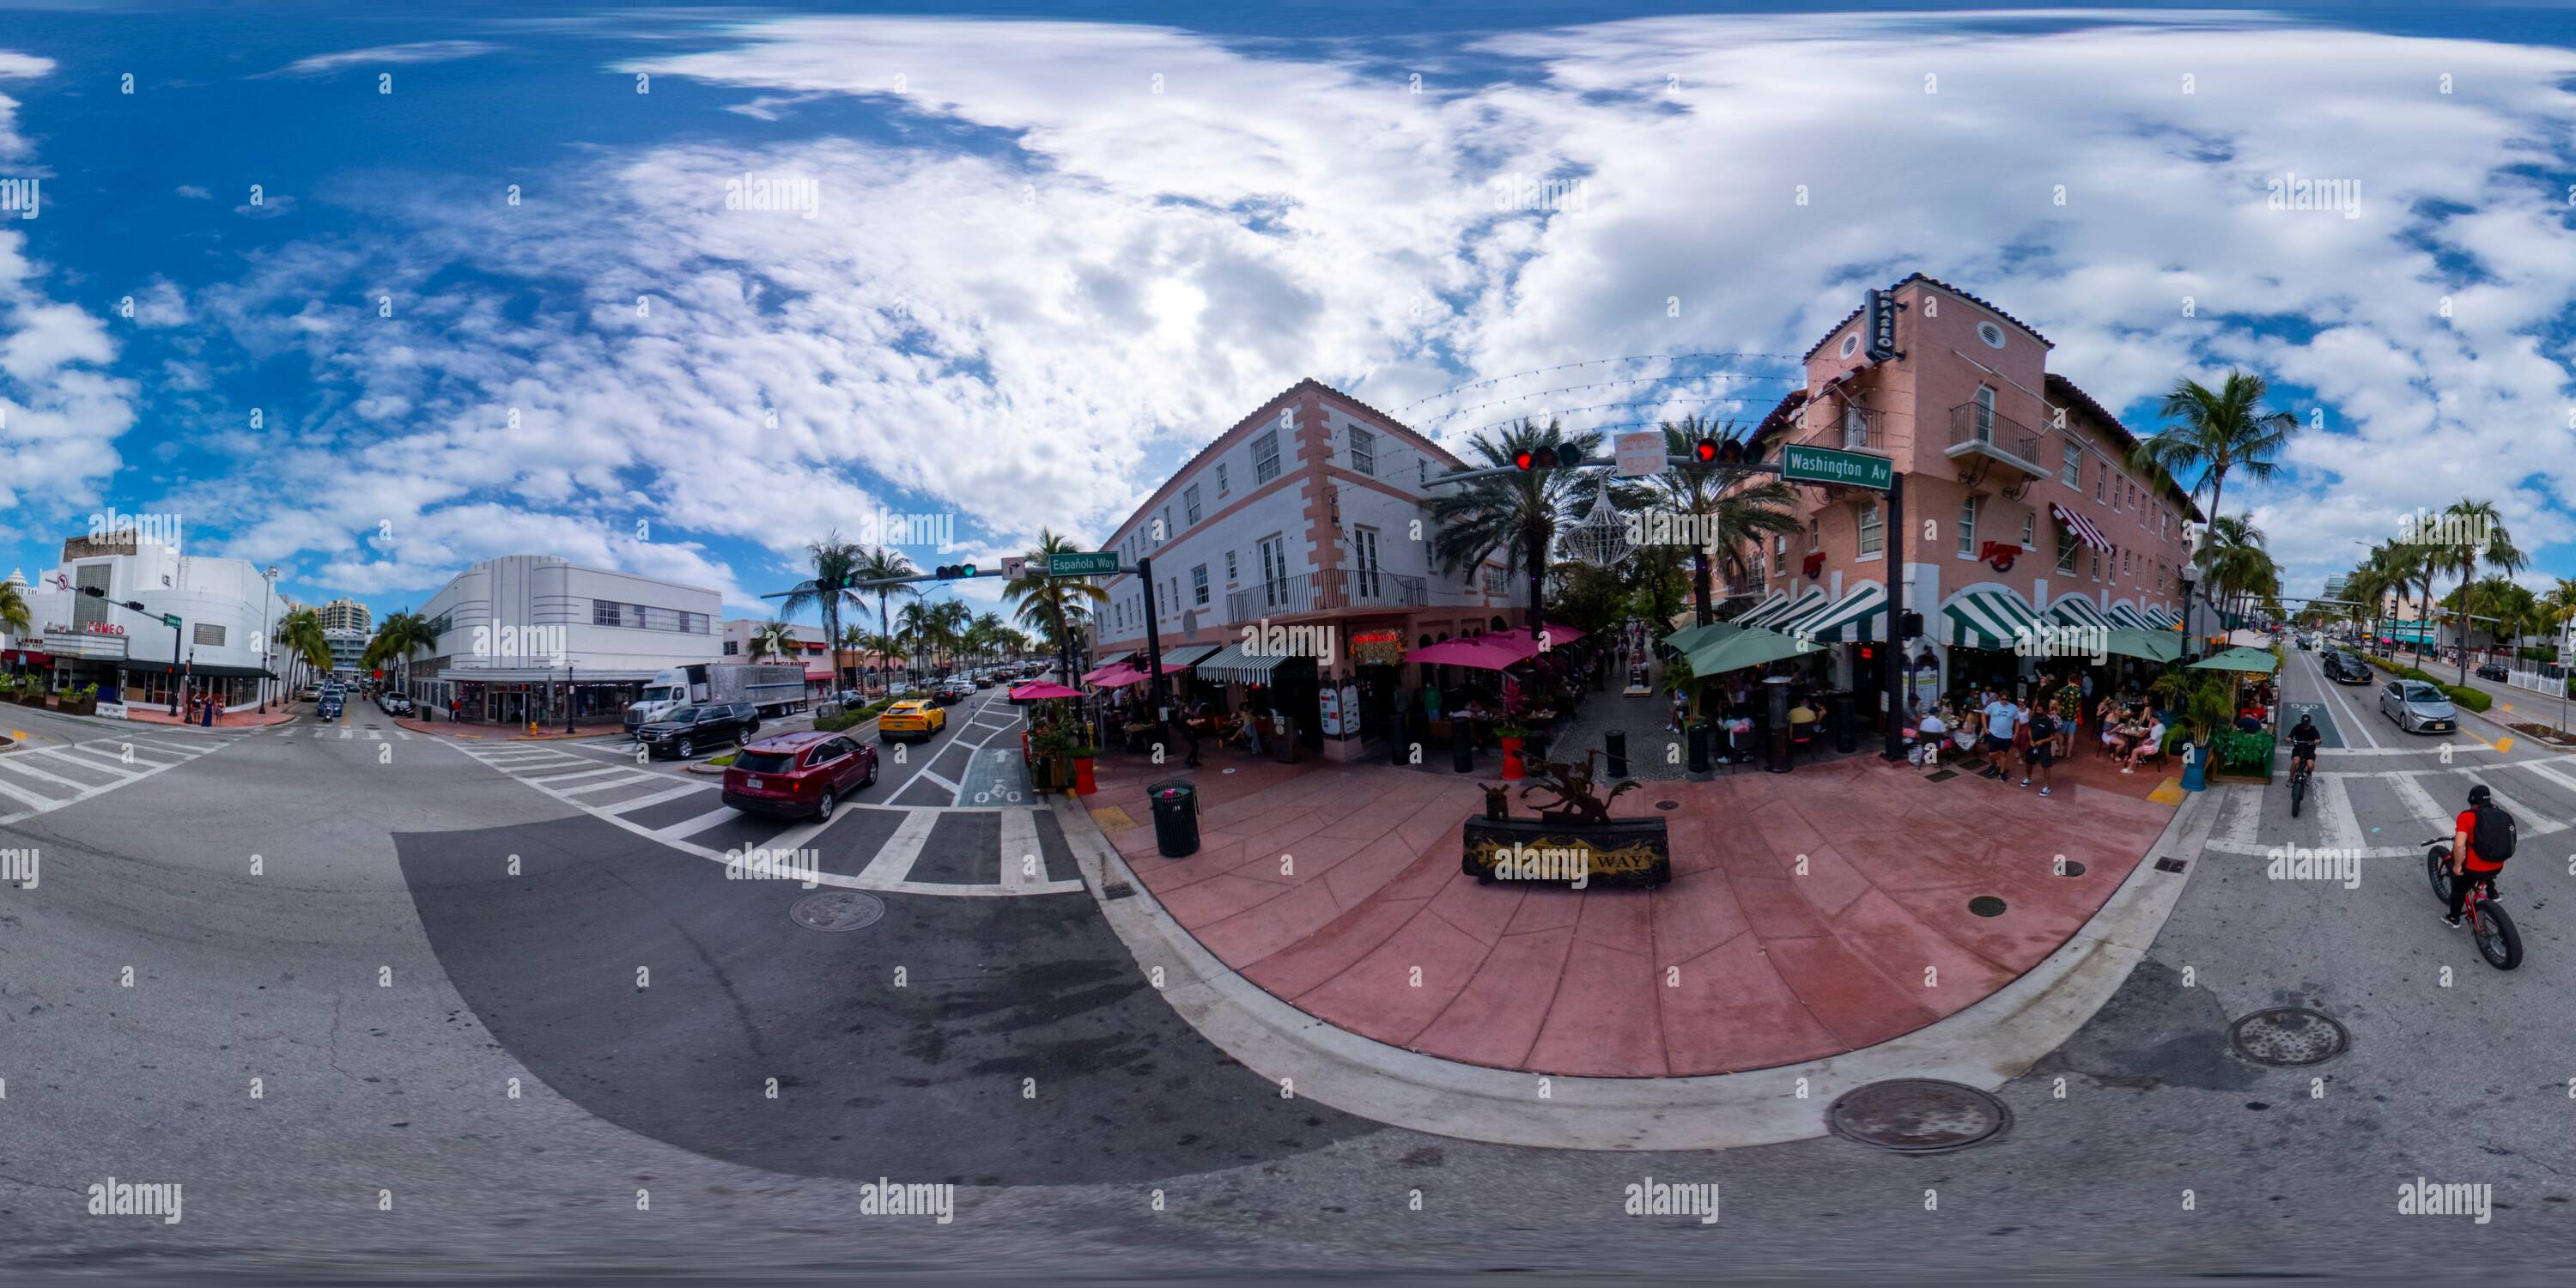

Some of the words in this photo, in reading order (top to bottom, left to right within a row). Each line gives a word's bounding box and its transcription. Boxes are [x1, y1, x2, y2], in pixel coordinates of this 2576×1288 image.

[1878, 300, 1893, 348] PASEO
[1791, 453, 1862, 478] Washington
[1871, 465, 1886, 480] Av
[1053, 559, 1095, 571] Española
[1097, 557, 1115, 570] Way
[88, 621, 124, 635] CAMEO
[1597, 855, 1642, 868] WAY
